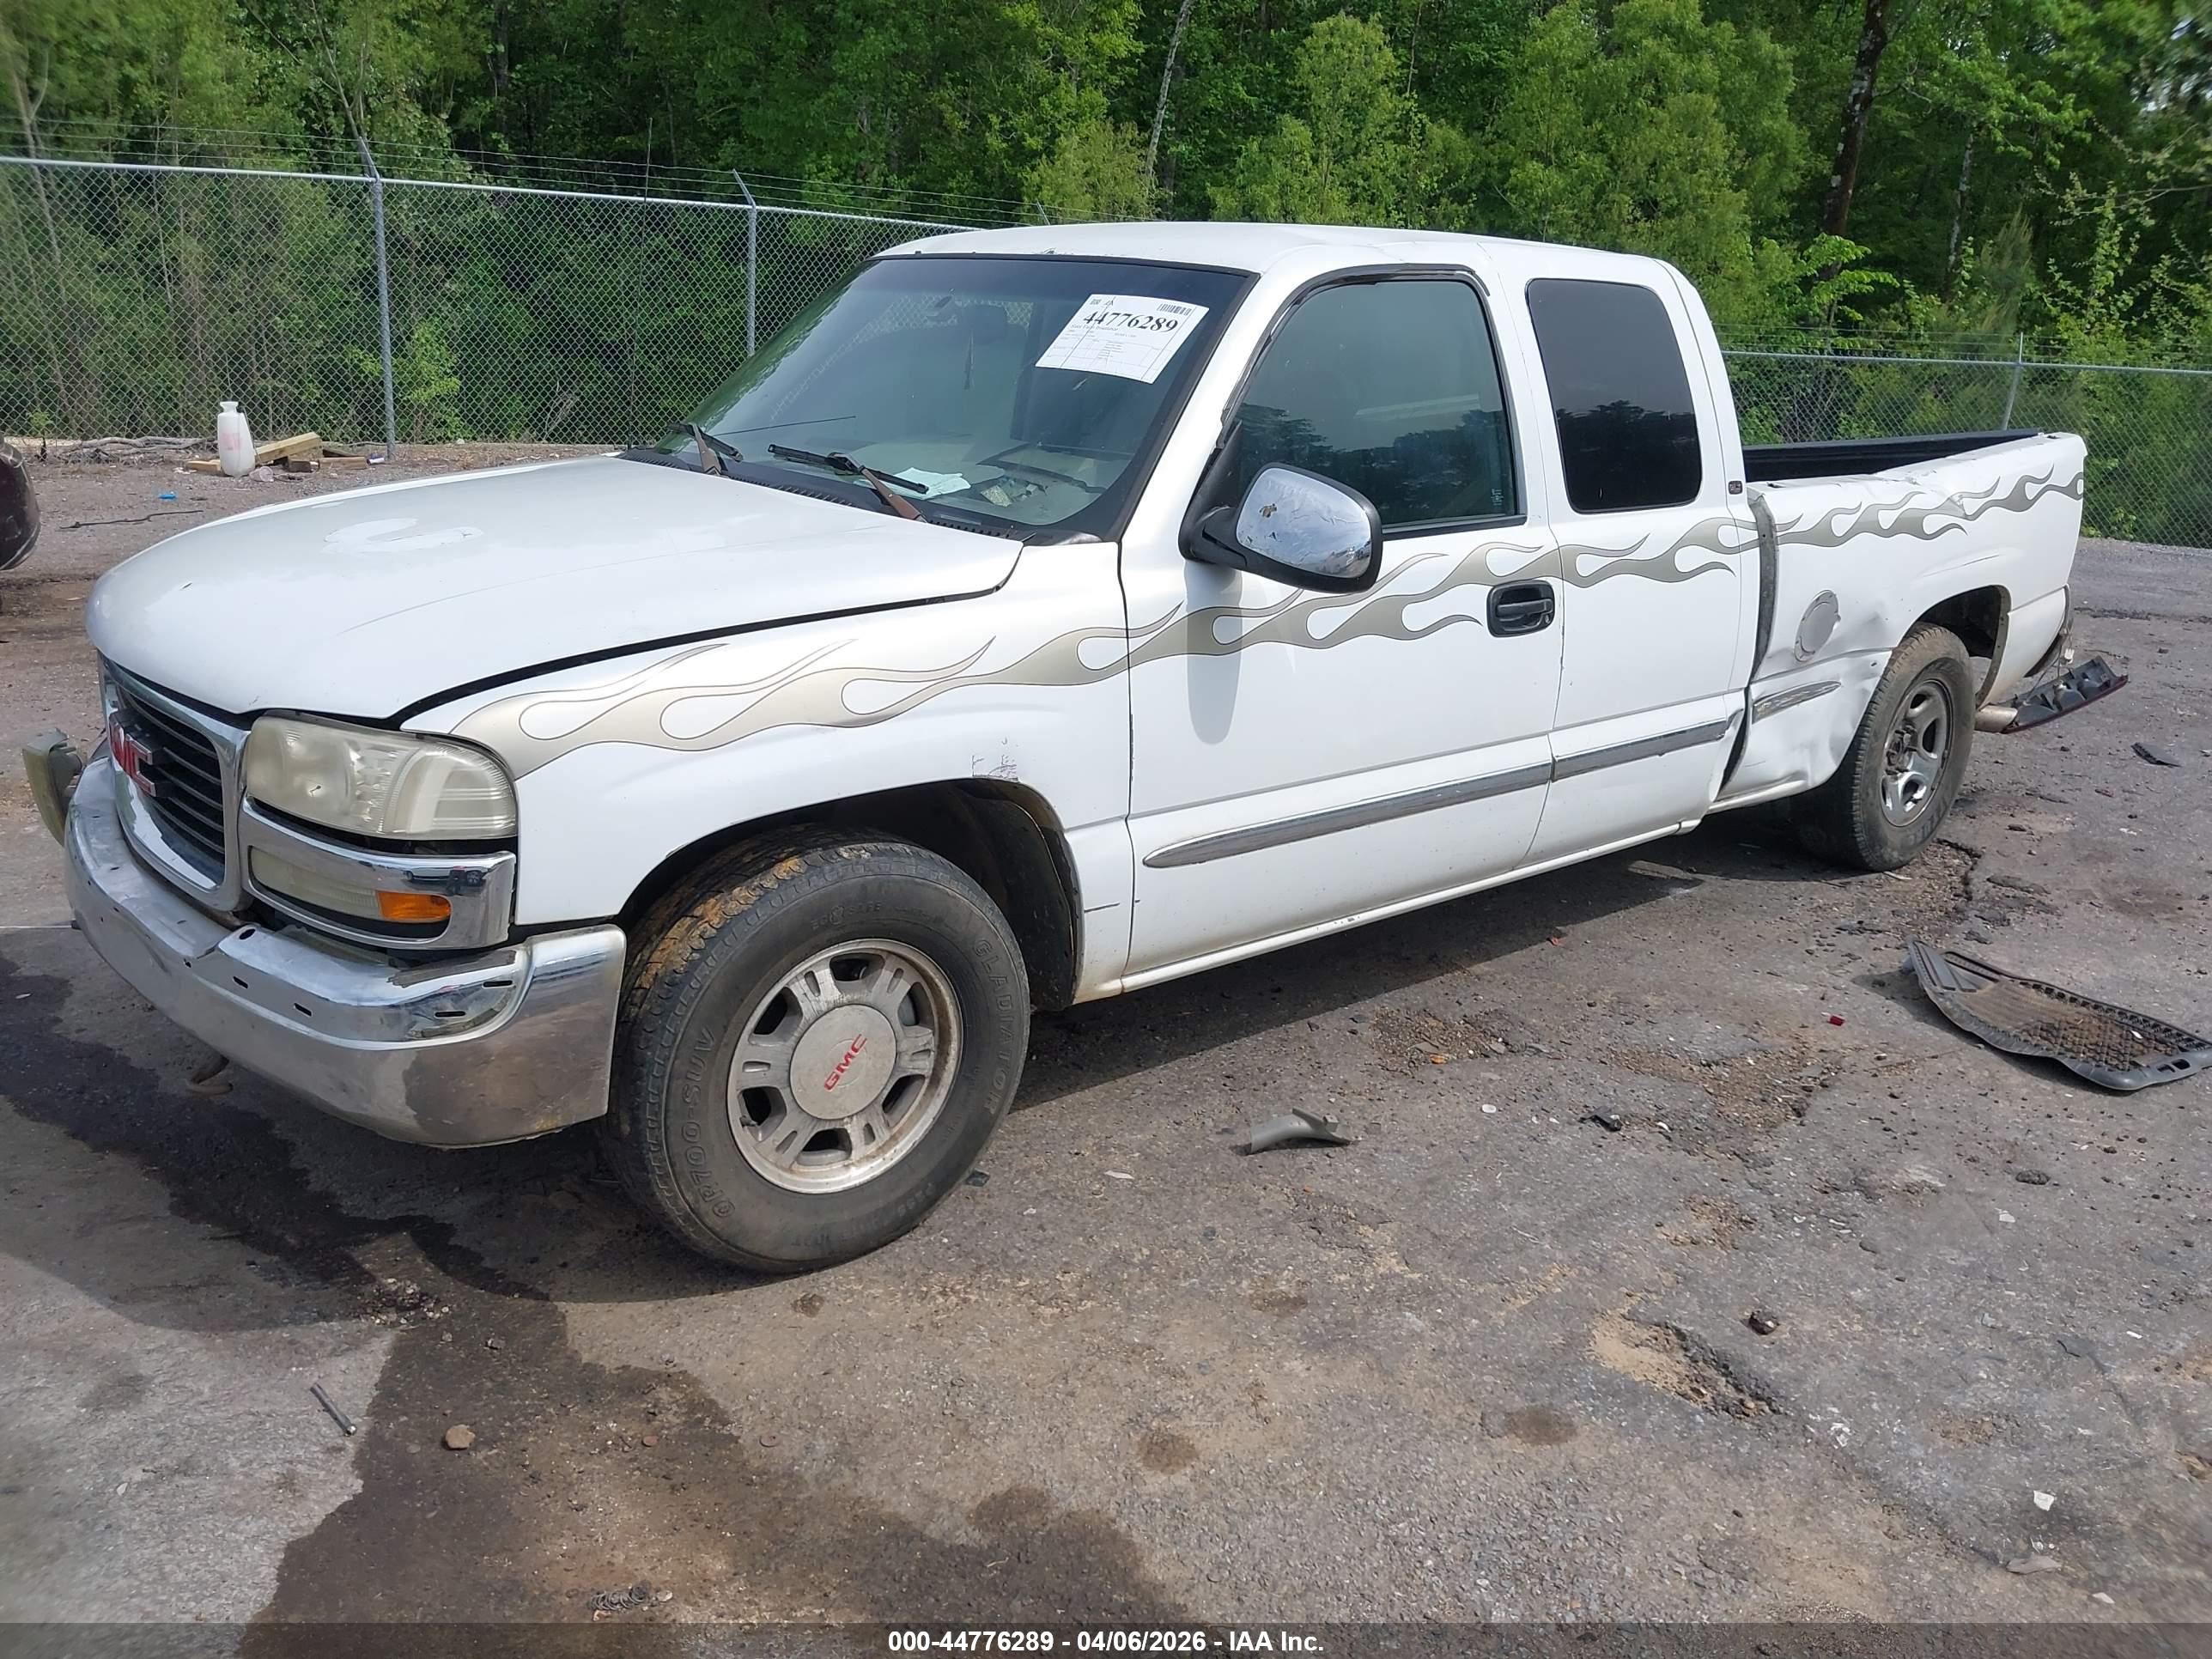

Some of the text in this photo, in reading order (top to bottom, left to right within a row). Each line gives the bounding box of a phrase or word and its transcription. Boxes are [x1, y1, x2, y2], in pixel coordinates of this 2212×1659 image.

[1083, 311, 1179, 333] 44776289
[109, 715, 156, 797] MC
[823, 1032, 868, 1091] GMC
[973, 939, 1015, 1115] GLADIATOR
